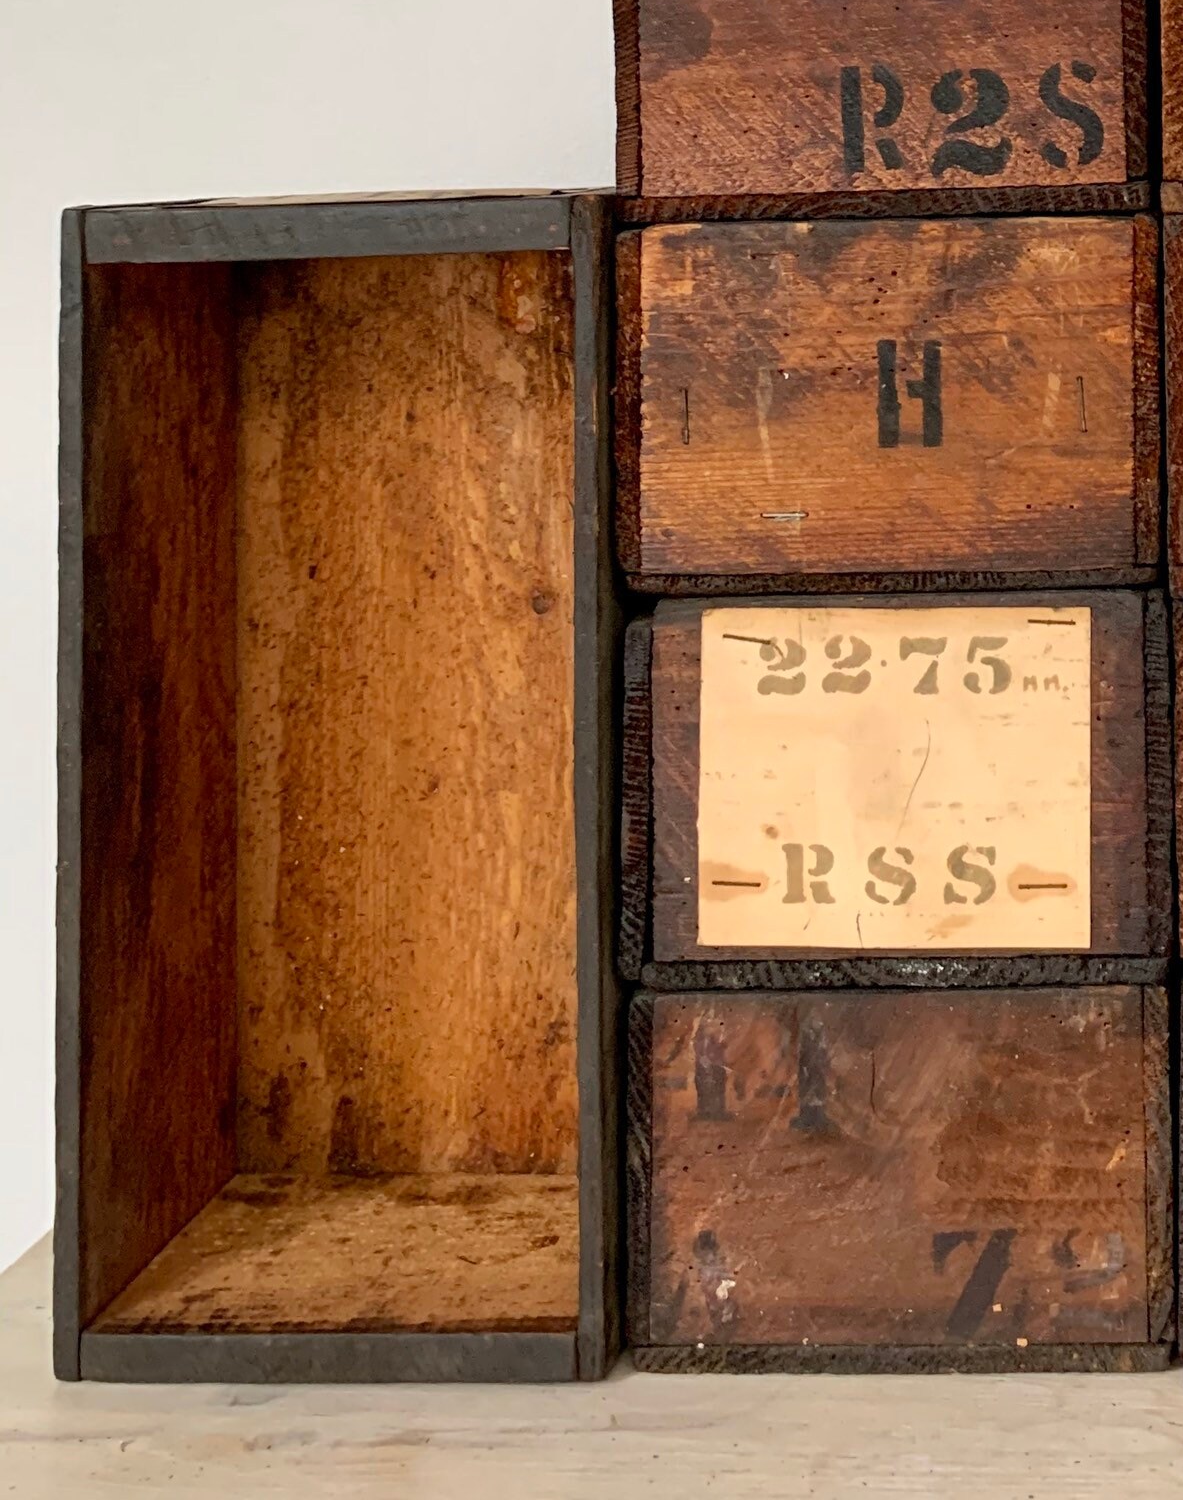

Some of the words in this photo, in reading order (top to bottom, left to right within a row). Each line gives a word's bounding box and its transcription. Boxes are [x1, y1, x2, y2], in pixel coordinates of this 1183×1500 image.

[840, 60, 1105, 178] R2S
[876, 339, 944, 449] H
[781, 842, 998, 906] RSS
